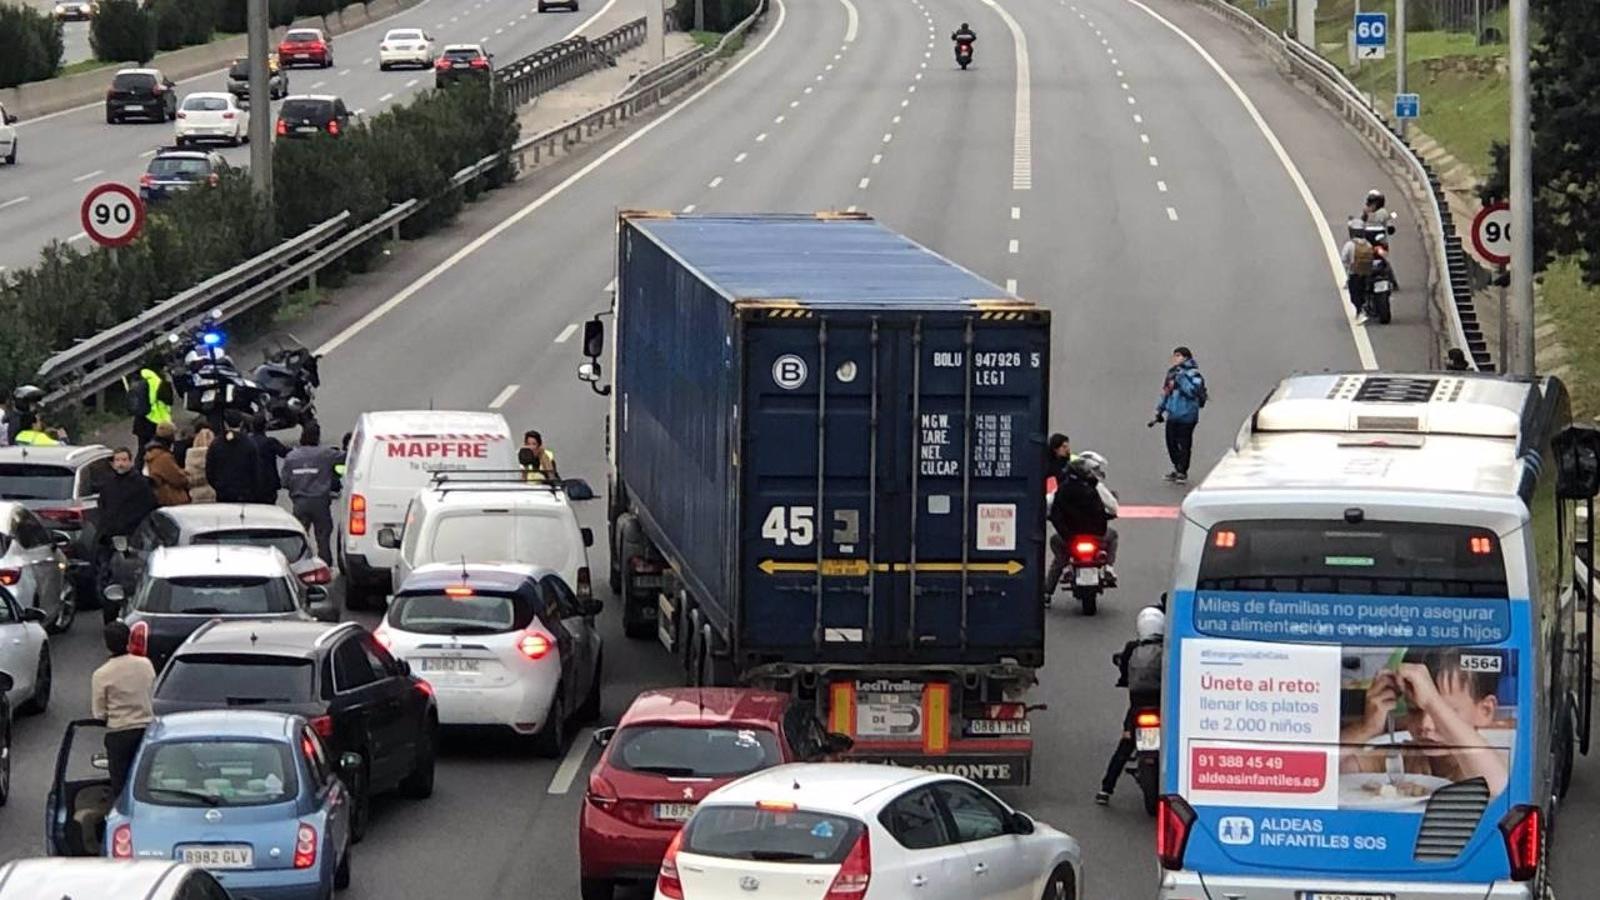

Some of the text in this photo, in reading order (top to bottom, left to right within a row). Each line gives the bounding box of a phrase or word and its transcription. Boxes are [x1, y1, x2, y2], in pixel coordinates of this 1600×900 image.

[1358, 22, 1384, 38] 60
[95, 203, 130, 224] 90
[934, 353, 1040, 368] BOLU 947926 5
[781, 362, 801, 381] B
[388, 442, 488, 458] MAPFRE
[762, 506, 814, 545] 45
[1199, 597, 1495, 624] Miles de familias no pueden asegurar
[1199, 619, 1227, 631] una
[1417, 626, 1427, 637] a
[1431, 627, 1459, 638] sus
[1463, 625, 1501, 642] hijos
[855, 679, 924, 692] LeciTrailer
[1200, 672, 1320, 694] Únete al reto:
[1200, 695, 1319, 716] llenar los platos
[1200, 716, 1312, 733] de 2.000 niños
[1198, 754, 1283, 769] 91 388 45 49
[1198, 772, 1319, 788] aldeasinfantiles.es
[1261, 817, 1323, 833] ALDEAS
[1261, 834, 1386, 850] INFANTILES SOS
[223, 850, 248, 863] GLV
